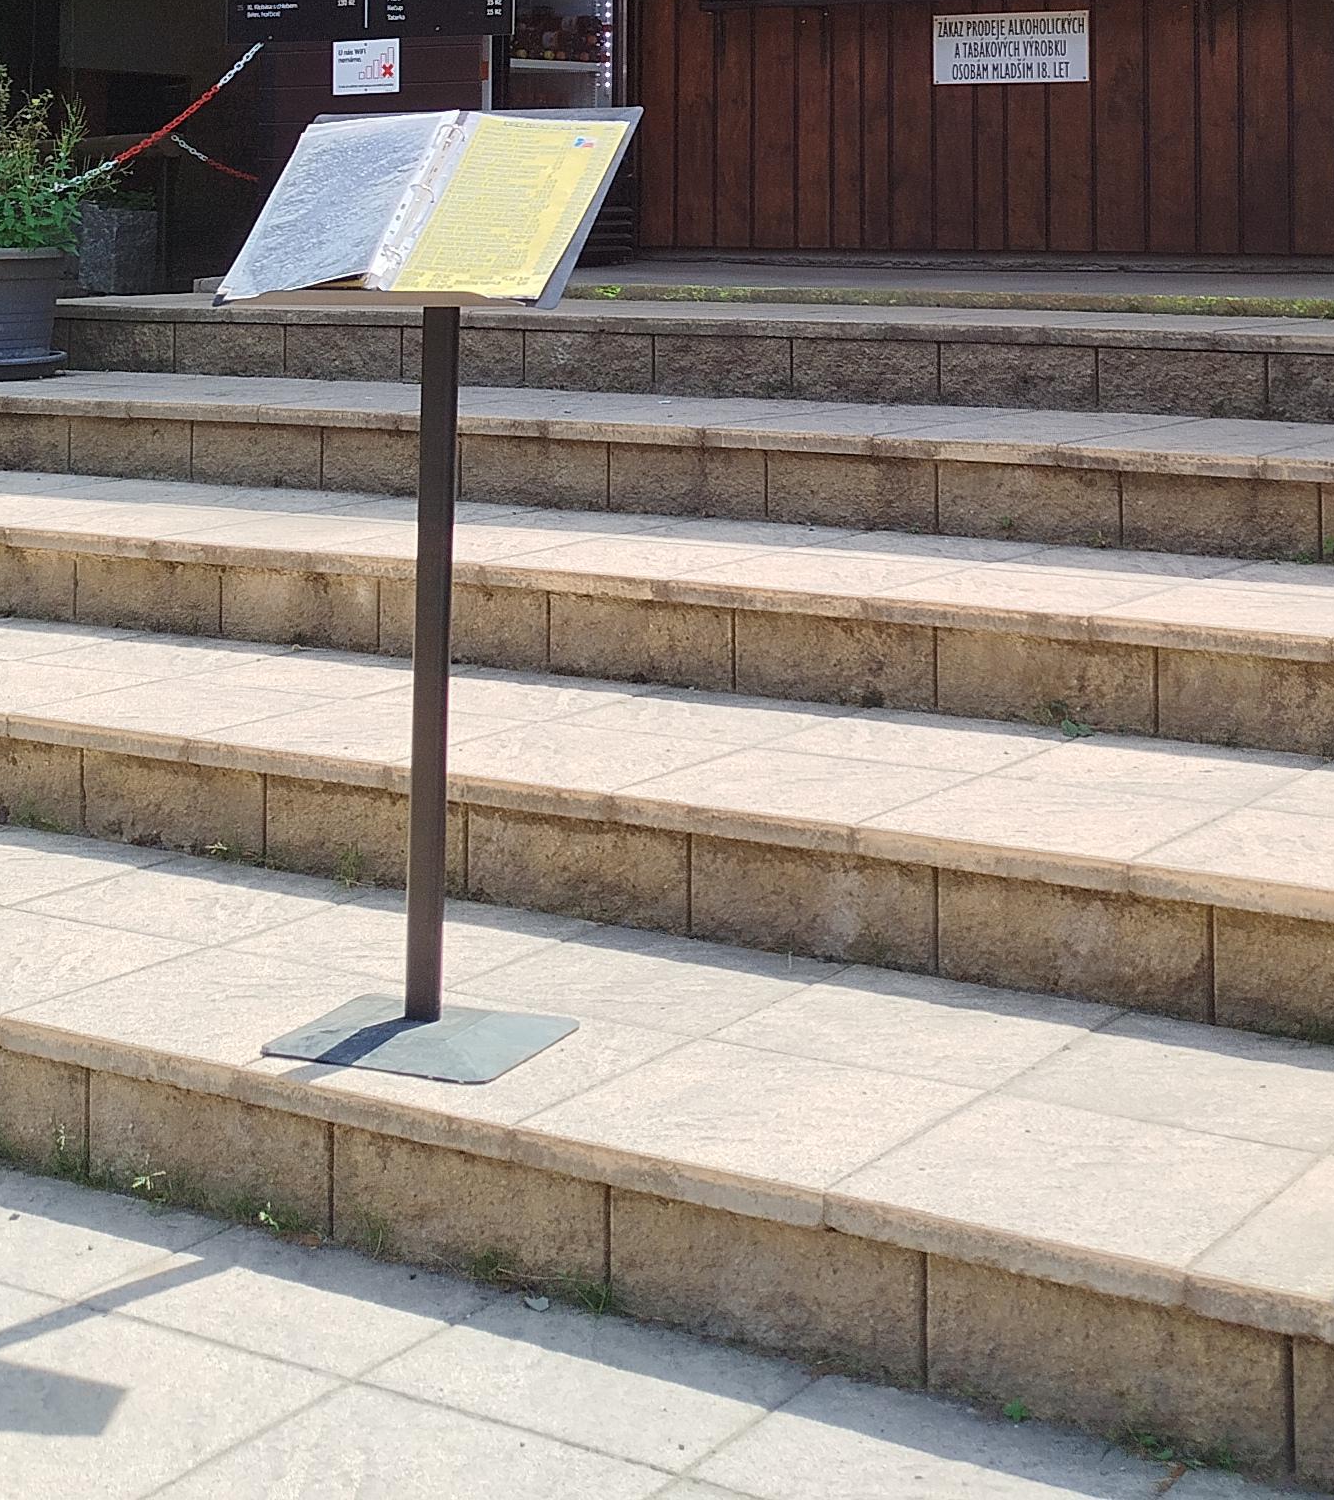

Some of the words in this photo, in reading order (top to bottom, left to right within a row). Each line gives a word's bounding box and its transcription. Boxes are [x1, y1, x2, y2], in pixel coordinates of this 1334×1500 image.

[937, 18, 964, 38] ZÁKAZ
[966, 19, 1006, 40] PRODEJE
[1008, 13, 1085, 36] ALKOHOLICKÝCH
[954, 43, 960, 59] A
[963, 37, 1020, 58] TABÁKOVÝCH
[952, 59, 989, 80] OSOBÁM
[992, 58, 1033, 79] MLADŠÍM
[1037, 62, 1050, 79] 18.
[1053, 61, 1070, 78] LET
